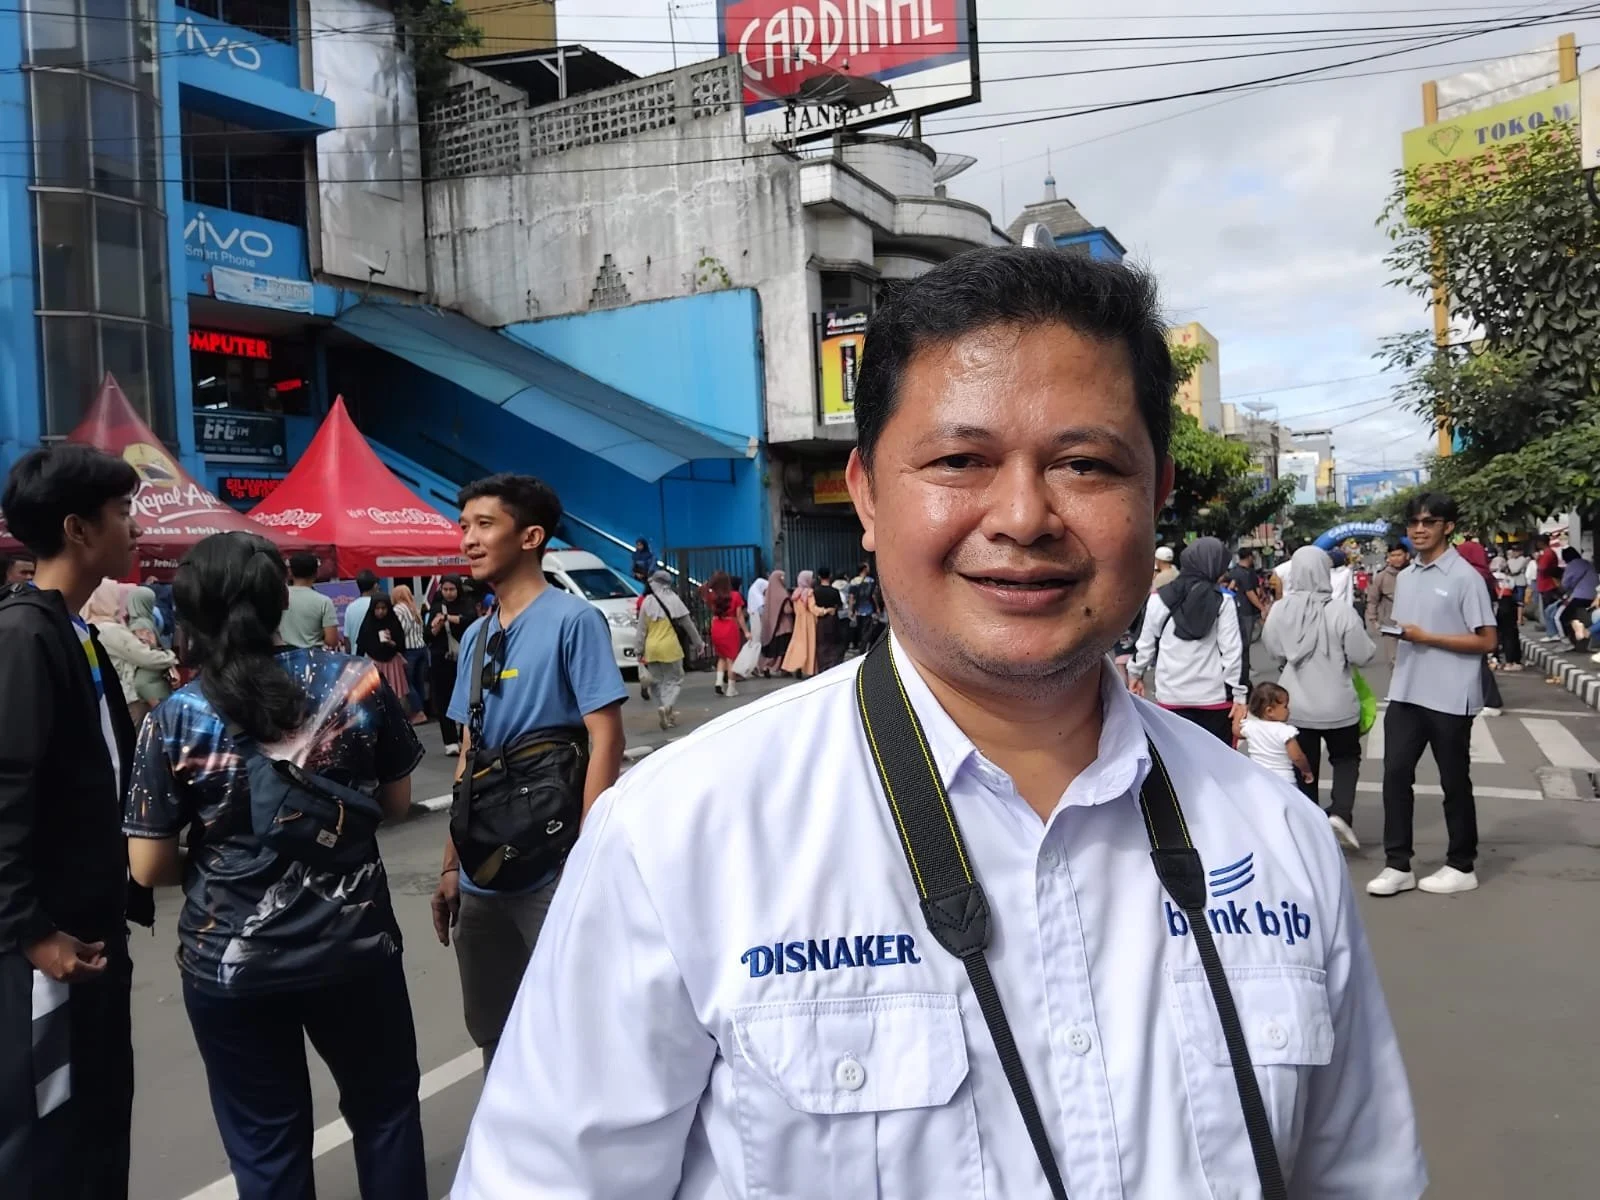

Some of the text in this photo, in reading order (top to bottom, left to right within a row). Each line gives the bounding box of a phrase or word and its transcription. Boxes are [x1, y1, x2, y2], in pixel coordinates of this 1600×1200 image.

[1475, 111, 1544, 145] TOKO
[221, 250, 256, 268] Phone
[1165, 900, 1311, 945] bnk bjb
[740, 933, 922, 978] DISNAKER
